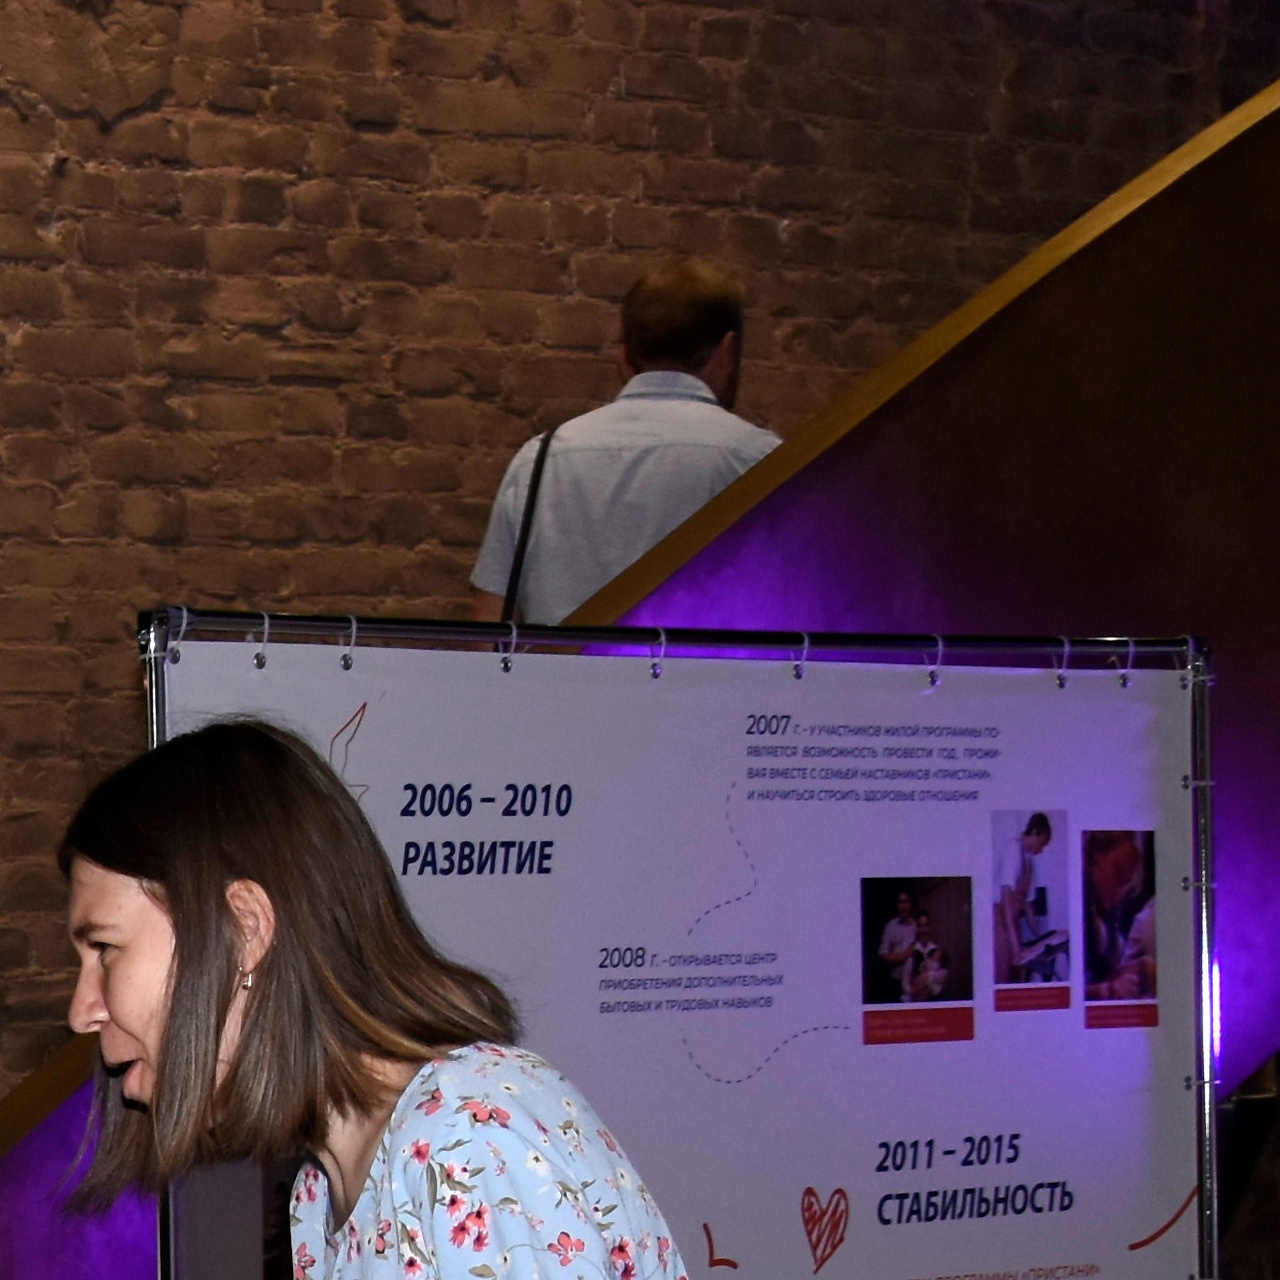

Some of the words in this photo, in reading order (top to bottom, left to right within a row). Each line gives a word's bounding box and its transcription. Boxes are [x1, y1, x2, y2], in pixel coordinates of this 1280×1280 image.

[745, 714, 791, 736] 2007
[816, 725, 881, 738] УЧАСТНИКОВ
[883, 723, 919, 738] ЖИЛОЙ
[922, 725, 982, 738] ПРОГРАММЫ
[746, 746, 798, 758] ЯВЛЯЕТСЯ
[802, 746, 878, 758] ВОЗМОЖНОСТЬ
[882, 747, 932, 759] ПРОВЕСТИ
[747, 767, 767, 779] ВАЯ
[770, 767, 808, 779] ВМЕСТЕ
[809, 768, 817, 779] С
[820, 766, 859, 780] СЕМЬЕЙ
[860, 768, 930, 780] НАСТАВНИКОВ
[399, 783, 473, 817] 2006
[501, 783, 573, 817] 2010
[747, 790, 755, 801] И
[757, 790, 815, 801] НАУЧИТЬСЯ
[817, 790, 860, 801] СТРОИТЬ
[863, 790, 917, 802] ЗДОРОВЫЕ
[919, 790, 979, 801] ОТНОШЕНИЯ
[401, 840, 554, 876] РАЗВИТИЕ
[598, 947, 646, 969] 2008
[669, 953, 742, 967] ОТКРЫВАЕТСЯ
[744, 952, 777, 966] ЦЕНТР
[598, 977, 682, 991] ПРИОБРЕТЕНИЯ
[684, 974, 784, 989] ДОПОЛНИТЕЛЬНЫХ
[599, 1000, 652, 1014] БЫТОВЫХ
[654, 999, 662, 1011] И
[665, 998, 720, 1012] ТРУДОВЫХ
[722, 996, 773, 1009] НАВЫКОВ
[875, 1138, 935, 1172] 2011
[960, 1133, 1021, 1167] 2015
[877, 1180, 1074, 1226] СТАБИЛЬНОСТЬ
